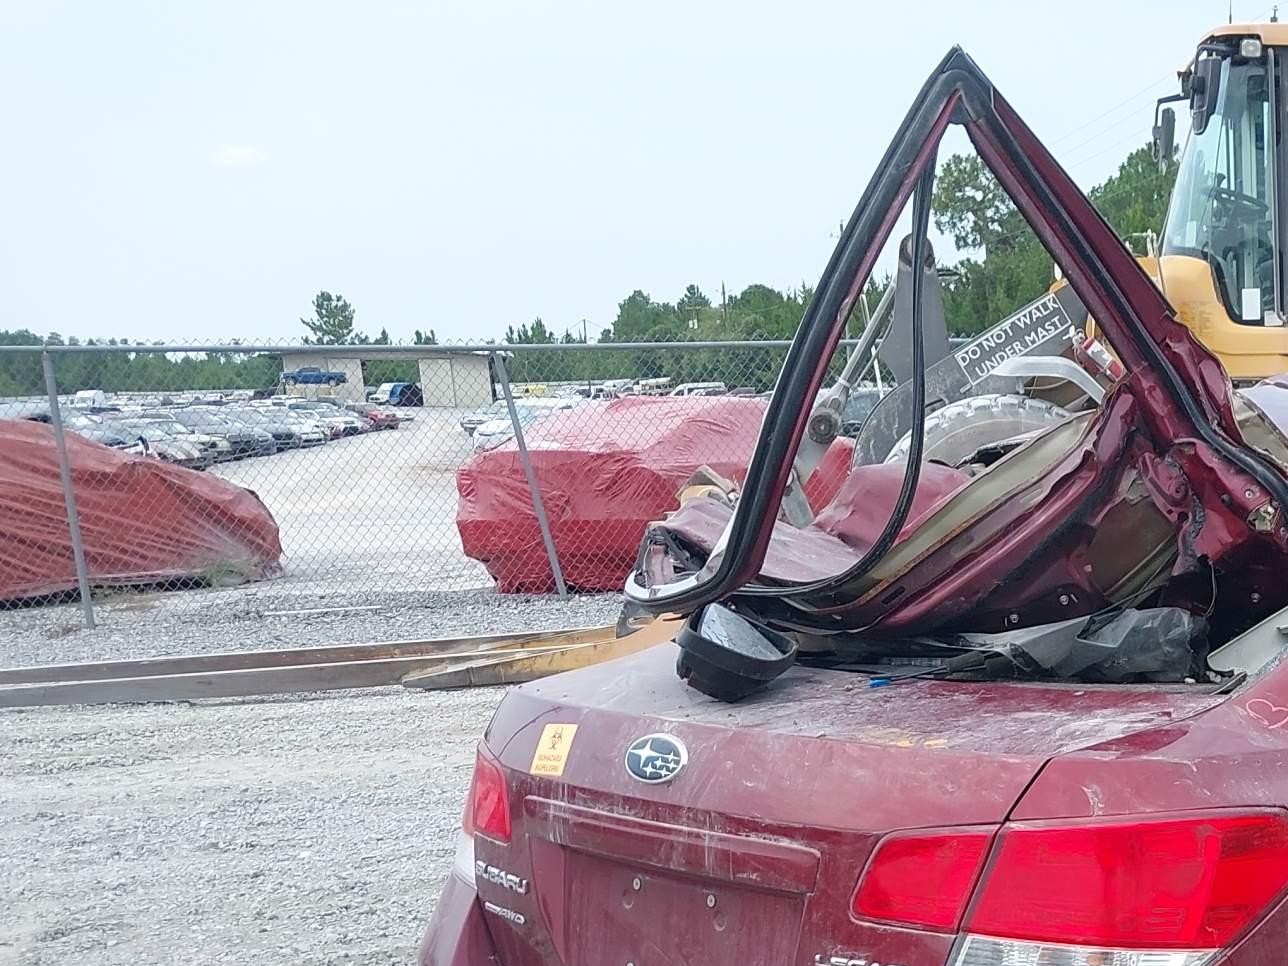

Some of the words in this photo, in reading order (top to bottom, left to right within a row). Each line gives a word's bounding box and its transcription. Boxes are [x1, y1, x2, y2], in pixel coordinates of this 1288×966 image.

[959, 347, 980, 366] DO
[982, 324, 1013, 351] NOT
[1015, 297, 1059, 329] WALK
[975, 341, 1025, 376] UNDER
[1024, 315, 1062, 347] MAST
[475, 860, 528, 894] SUBARU
